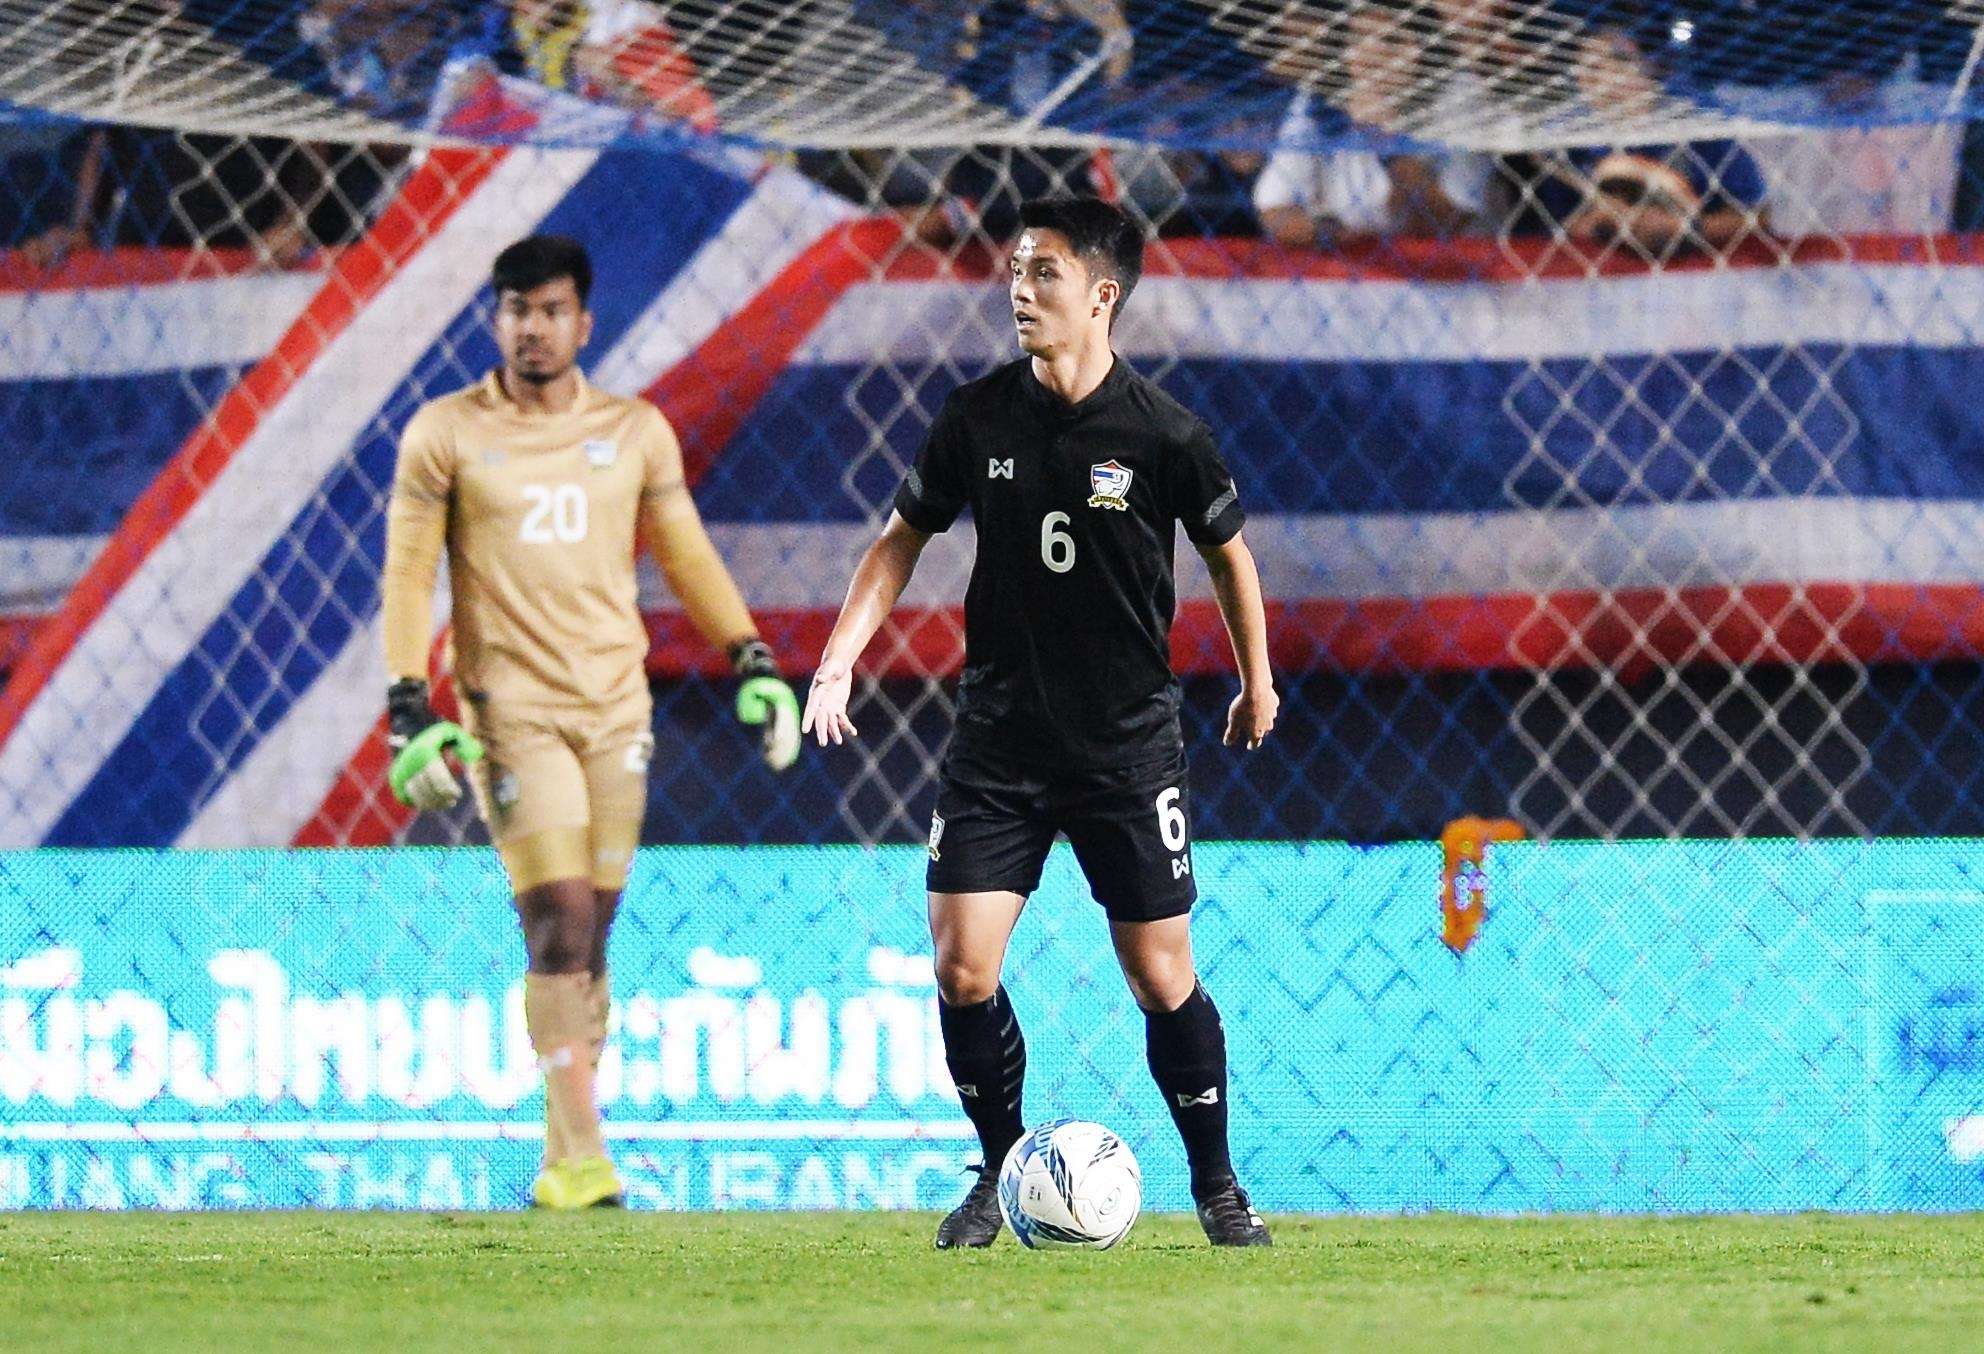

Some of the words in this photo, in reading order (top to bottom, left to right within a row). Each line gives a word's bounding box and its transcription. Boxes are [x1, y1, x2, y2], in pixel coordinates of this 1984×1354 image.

[519, 482, 588, 543] 20
[1041, 510, 1076, 573] 6
[1155, 786, 1186, 852] 6
[303, 1153, 489, 1208] THAI
